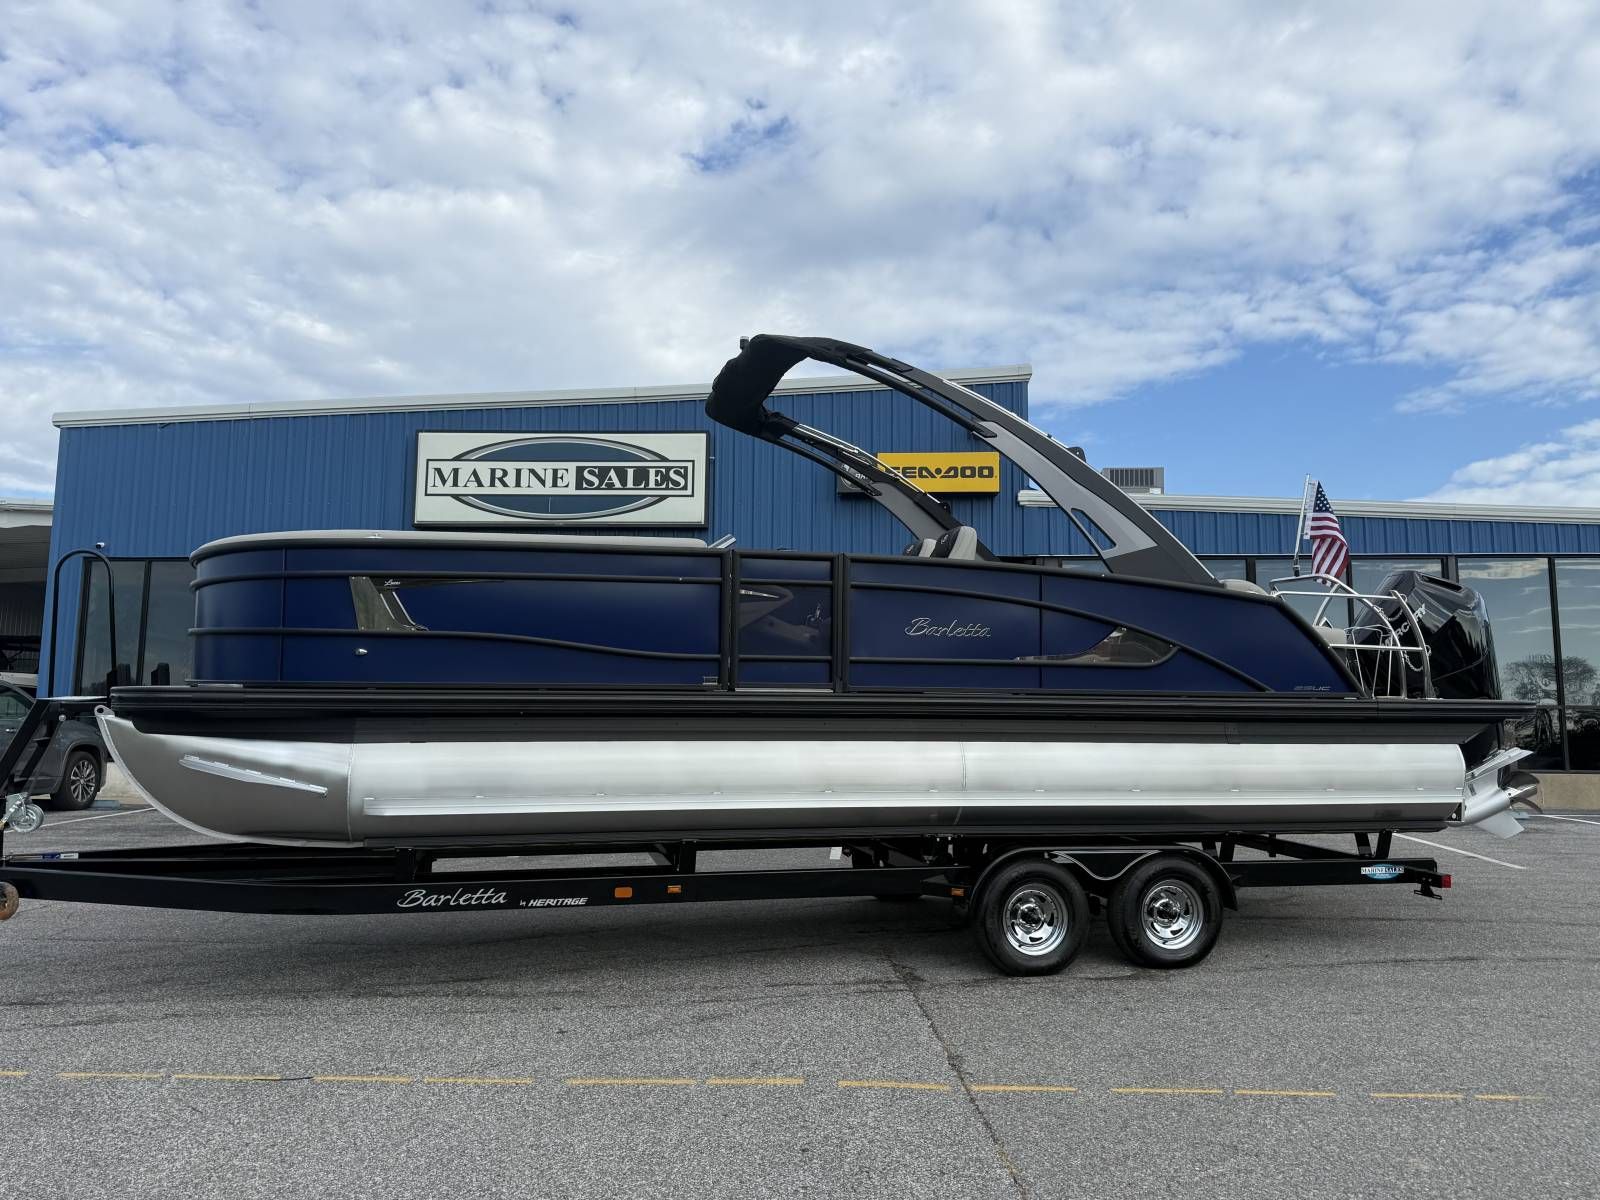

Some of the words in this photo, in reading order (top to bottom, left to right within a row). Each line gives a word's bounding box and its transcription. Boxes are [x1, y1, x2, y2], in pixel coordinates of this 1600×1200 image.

[430, 467, 570, 489] MARINE
[582, 467, 687, 489] SALES
[904, 617, 991, 637] Barletta
[1381, 602, 1426, 653] MRCRY
[397, 888, 508, 908] Barletta
[528, 897, 588, 907] HERITAGE
